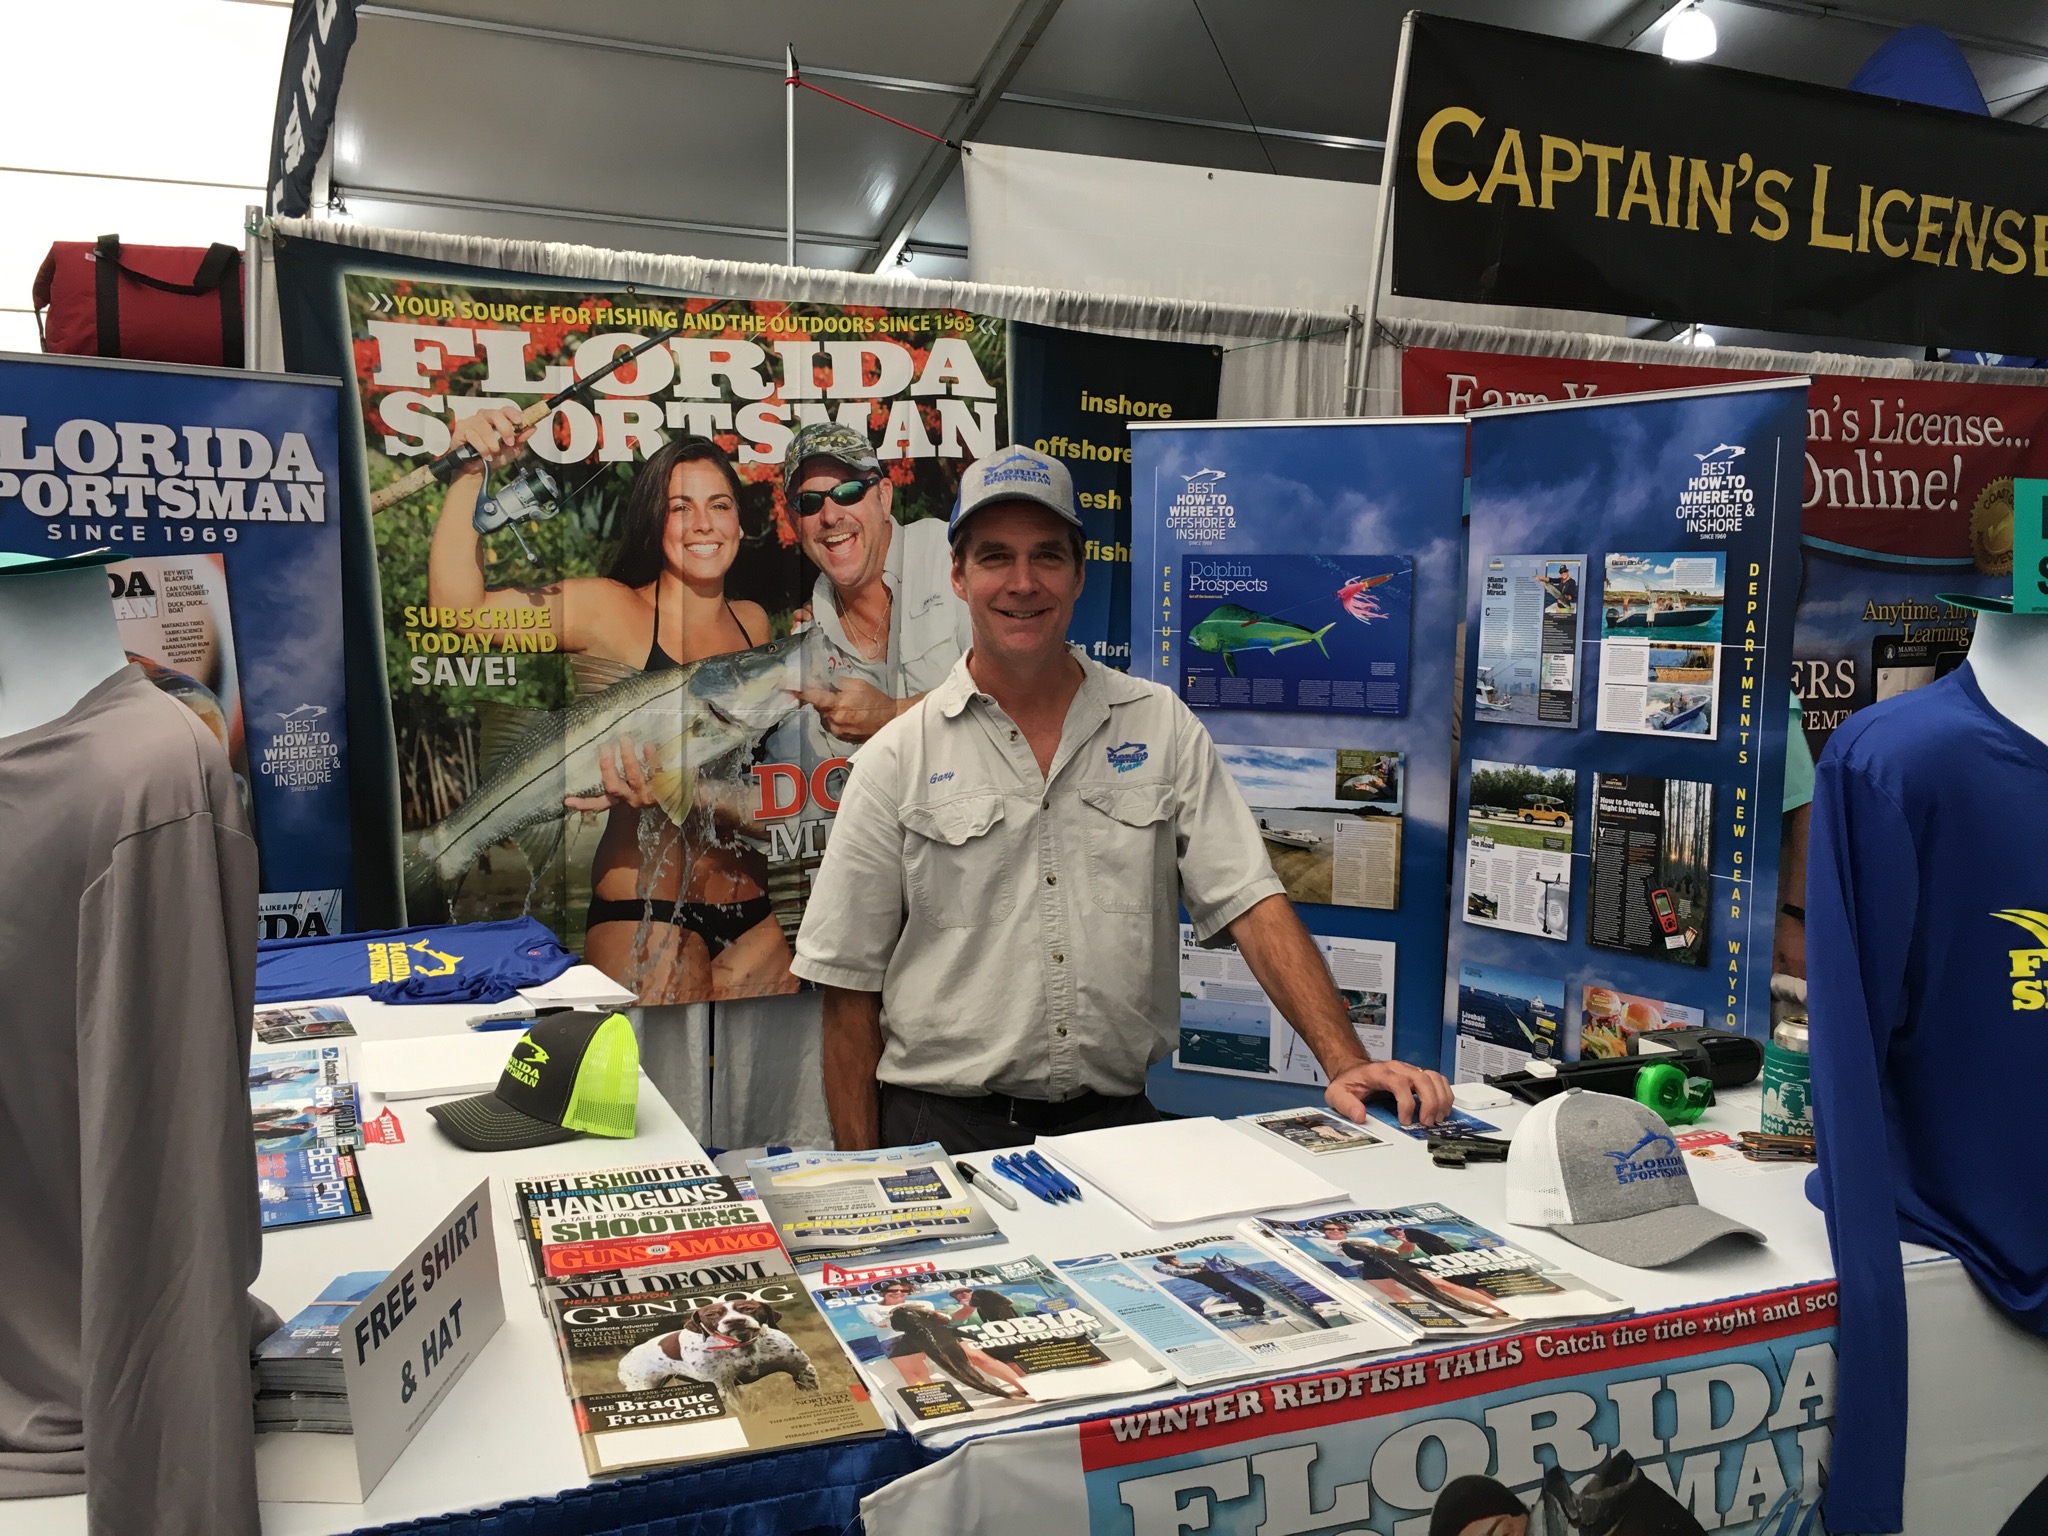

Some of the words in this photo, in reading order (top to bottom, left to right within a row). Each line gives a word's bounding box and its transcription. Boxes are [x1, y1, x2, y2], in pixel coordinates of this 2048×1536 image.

[1416, 106, 1794, 242] CAPTAIN'S
[393, 295, 456, 318] YOUR
[461, 301, 546, 323] SOURCE
[550, 305, 592, 325] FOR
[595, 307, 679, 329] FISHING
[682, 312, 727, 331] AND
[729, 314, 767, 332] THE
[769, 315, 875, 334] OUTDOORS
[879, 314, 930, 333] SINCE
[934, 313, 976, 333] 1969
[367, 319, 997, 400] FLORIDA
[1081, 391, 1173, 419] inshore
[1869, 398, 2031, 447] License...
[0, 415, 324, 483] LORIDA
[1701, 461, 1735, 476] BEST
[1187, 483, 1217, 494] BEST
[1688, 475, 1746, 491] HOW-TO
[1176, 494, 1227, 505] HOW-TO
[1680, 489, 1754, 505] WHERE-TO
[1169, 506, 1234, 517] WHERE-TO
[1675, 504, 1743, 519] OFFSHORE
[1744, 503, 1755, 517] &
[47, 523, 146, 541] SINCE
[164, 526, 239, 543] 1969
[1166, 517, 1226, 529] OFFSHORE
[1227, 517, 1237, 529] &
[1686, 518, 1743, 533] INSHORE
[1176, 529, 1226, 540] INSHORE
[164, 575, 194, 583] BLACKFIN
[1189, 561, 1252, 580] Dolphin
[1486, 576, 1508, 584] Miami's
[1189, 576, 1268, 596] Prospects
[1486, 589, 1507, 597] Miracle
[404, 606, 551, 630] SUBSCRIBE
[1161, 566, 1172, 667] FEATURE
[1862, 598, 1941, 627] Anytime,
[406, 631, 494, 654] TODAY
[501, 631, 558, 653] AND
[1903, 622, 1970, 647] Learning
[411, 656, 519, 687] SAVE!
[1737, 562, 1760, 765] DEPARTMENTS
[285, 720, 318, 733] BEST
[272, 732, 330, 747] HOW-TO
[264, 744, 338, 761] WHERE-TO
[260, 757, 331, 775] OFFSHORE
[332, 756, 341, 769] &
[274, 770, 332, 787] INSHORE
[929, 770, 956, 785] Gary
[1600, 796, 1614, 805] How
[1614, 798, 1622, 806] to
[1622, 799, 1648, 808] Survive
[1600, 803, 1617, 813] Night
[1625, 806, 1637, 814] the
[1637, 808, 1661, 817] Woods
[1479, 841, 1495, 850] Road
[1461, 1011, 1486, 1023] Livebait
[1461, 1018, 1486, 1029] Lessons
[1763, 1119, 1784, 1133] LONE
[306, 1147, 338, 1180] BEST
[515, 1163, 712, 1195] RIFLESHOOTER
[527, 1192, 550, 1201] TOP
[551, 1188, 606, 1200] HANDGUN
[607, 1183, 660, 1196] SECURITY
[661, 1177, 718, 1191] PRODUCTS
[311, 1180, 346, 1216] BOAT
[536, 1182, 729, 1218] HANDGUNS
[568, 1214, 595, 1224] TALE
[595, 1213, 608, 1221] OF
[608, 1211, 635, 1220] TWO
[680, 1202, 743, 1215] REMINGTONS
[550, 1206, 761, 1243] SHOOTING
[551, 1245, 654, 1270] GUNS
[660, 1230, 777, 1256] AMMO
[1120, 1244, 1174, 1259] Action
[1174, 1234, 1237, 1251] Spotter
[354, 1269, 418, 1367] FREE
[421, 1201, 480, 1293] SHIRT
[817, 1268, 995, 1303] FLORIDA
[563, 1296, 610, 1307] HELL'S
[613, 1291, 670, 1304] CANYON
[563, 1300, 683, 1325] GUN
[686, 1284, 798, 1312] DOG
[595, 1324, 620, 1332] Dakota
[621, 1321, 659, 1330] Adventure
[622, 1326, 656, 1335] IRON
[967, 1319, 1103, 1350] COUNTDOWN
[401, 1360, 418, 1404] &
[421, 1298, 463, 1378] HAT
[574, 1338, 636, 1349] CHICKENS
[1109, 1389, 1264, 1443] WINTER
[1270, 1361, 1427, 1411] REDFISH
[1434, 1338, 1525, 1382] TAILS
[1535, 1330, 1605, 1360] Catch
[1611, 1325, 1648, 1348] the
[1653, 1316, 1698, 1341] tide
[1702, 1304, 1758, 1336] right
[1762, 1295, 1802, 1323] and
[589, 1405, 615, 1413] THE
[615, 1392, 716, 1414] Braque
[606, 1403, 721, 1428] Francais
